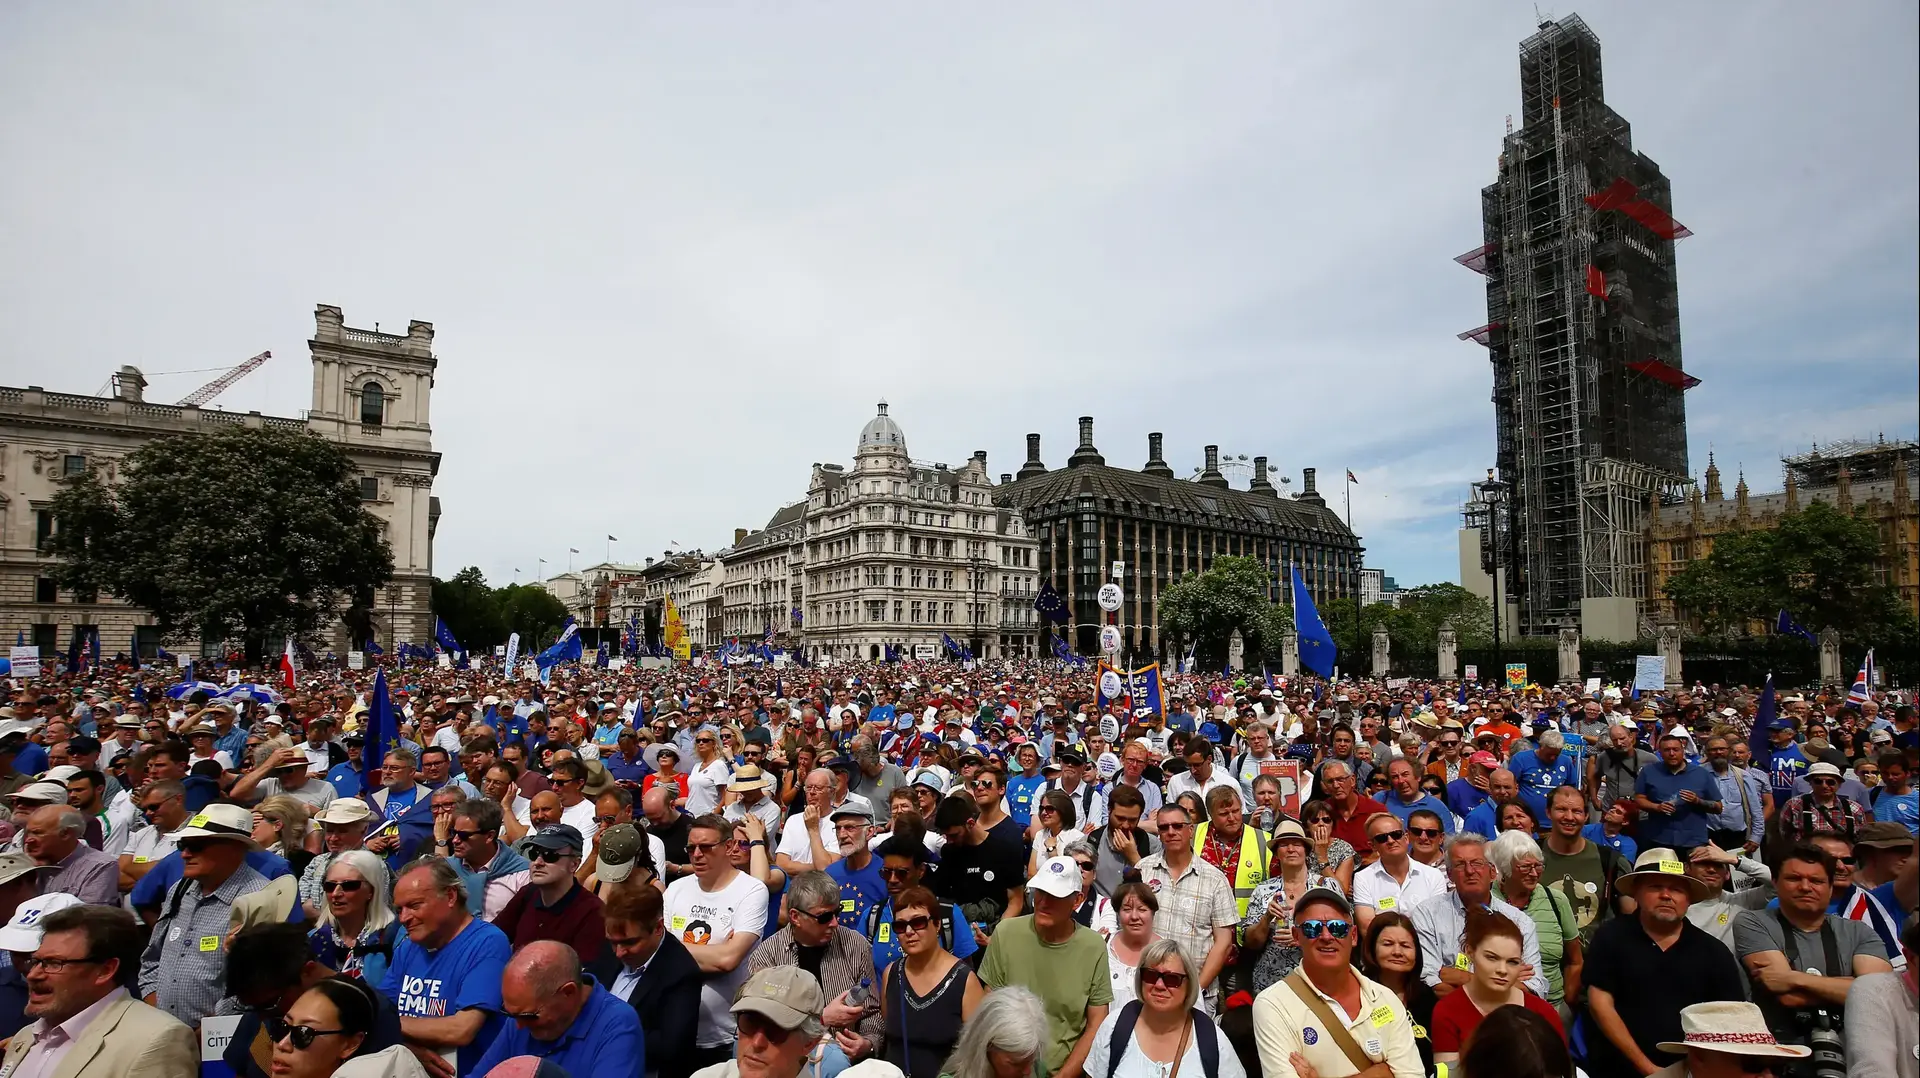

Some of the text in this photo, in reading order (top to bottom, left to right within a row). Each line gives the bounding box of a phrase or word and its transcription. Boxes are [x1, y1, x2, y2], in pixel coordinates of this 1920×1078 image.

[690, 904, 718, 917] COMING
[402, 974, 442, 998] VOTE
[398, 992, 447, 1017] EMAIN
